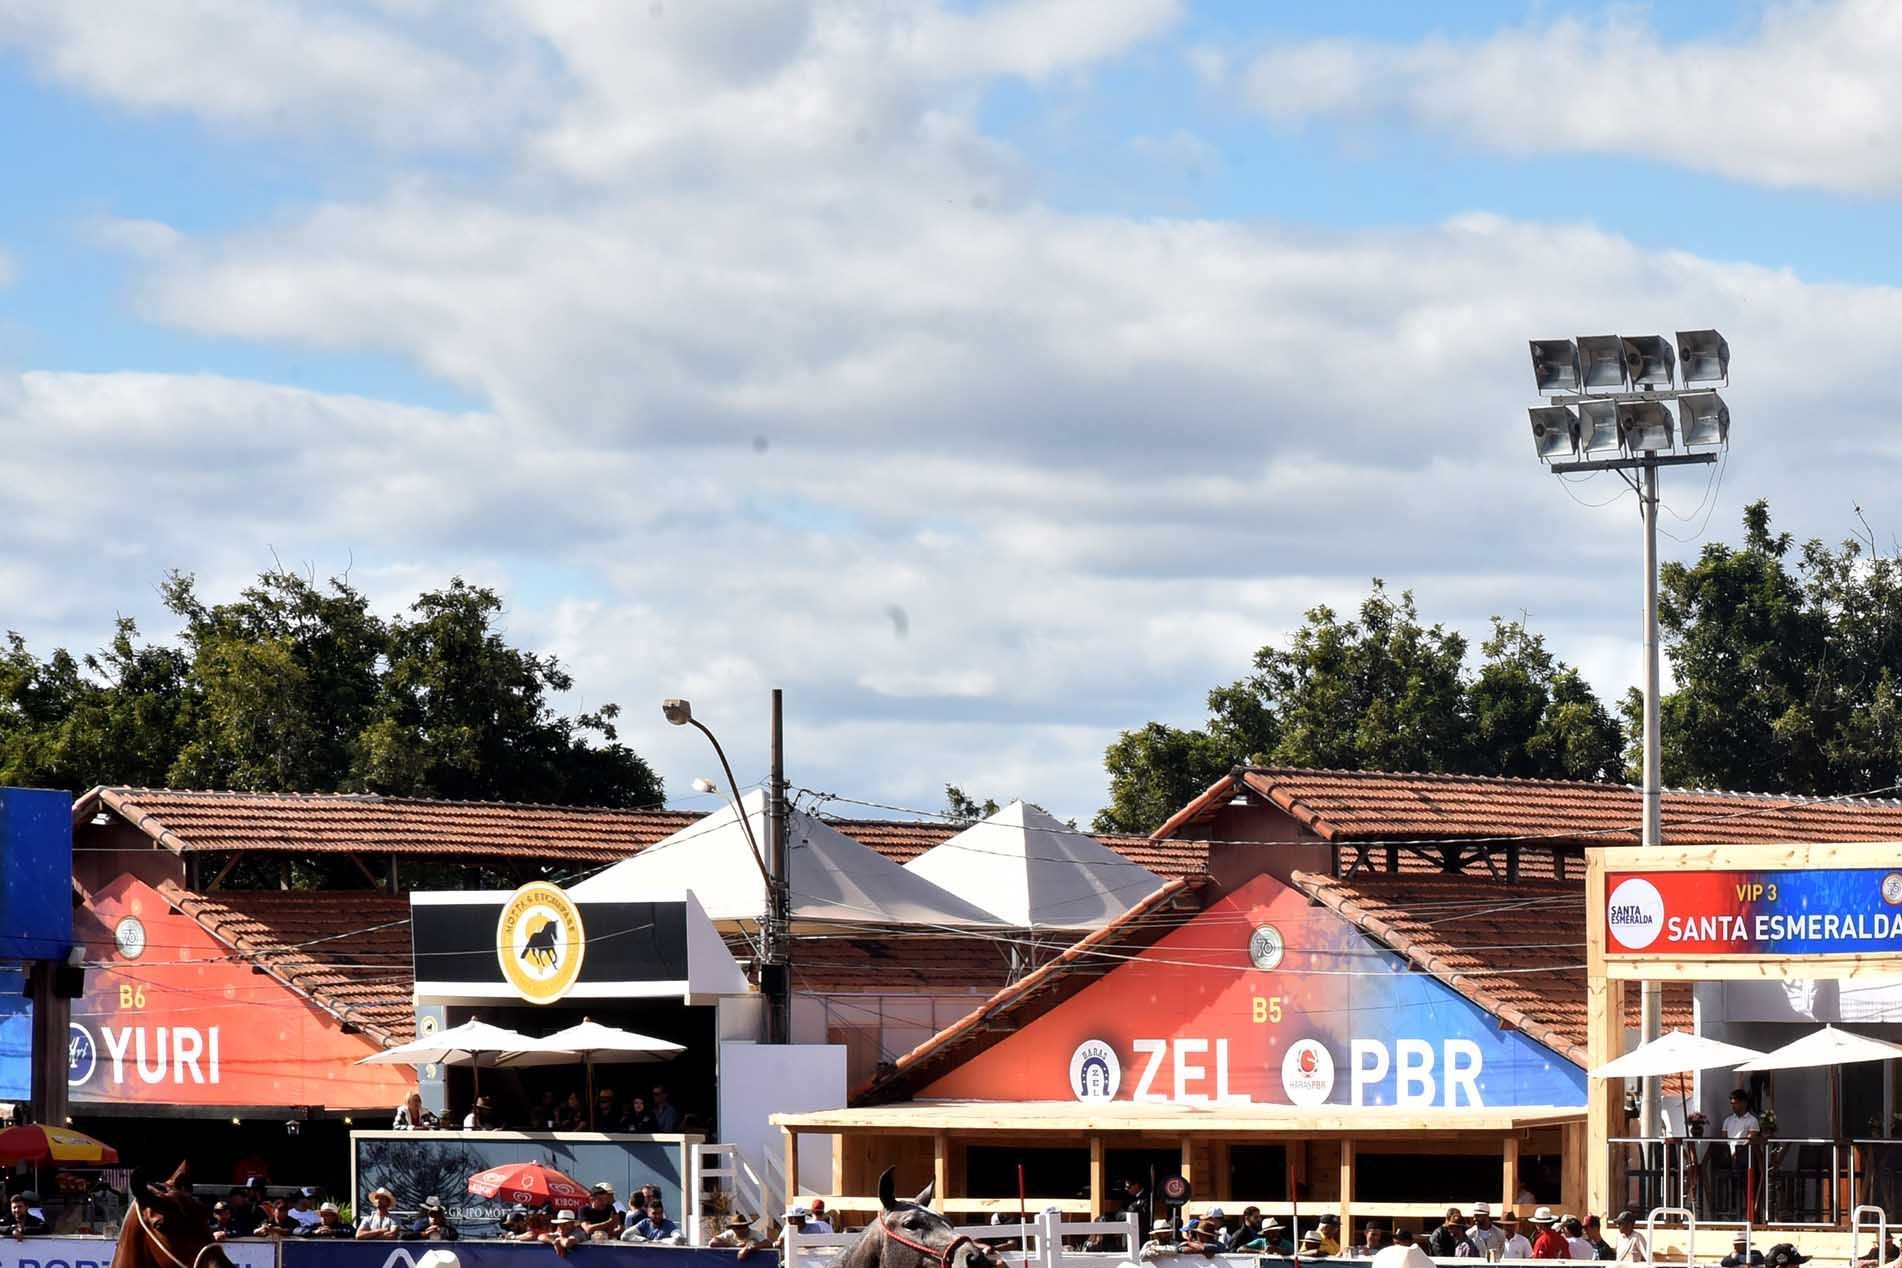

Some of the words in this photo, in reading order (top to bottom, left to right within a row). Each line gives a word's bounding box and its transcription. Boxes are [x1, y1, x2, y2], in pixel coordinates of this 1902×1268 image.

[1736, 884, 1763, 901] VIP
[1768, 884, 1777, 901] 3
[1611, 905, 1641, 915] SANTA
[1611, 914, 1653, 924] ESMERALDA
[1667, 916, 1748, 941] SANTA
[120, 985, 145, 1008] B6
[1253, 997, 1282, 1023] B5
[101, 1027, 219, 1084] YURI
[1133, 1039, 1251, 1101] ZEL
[1351, 1039, 1485, 1106] PBR
[449, 1208, 481, 1219] GRUPO
